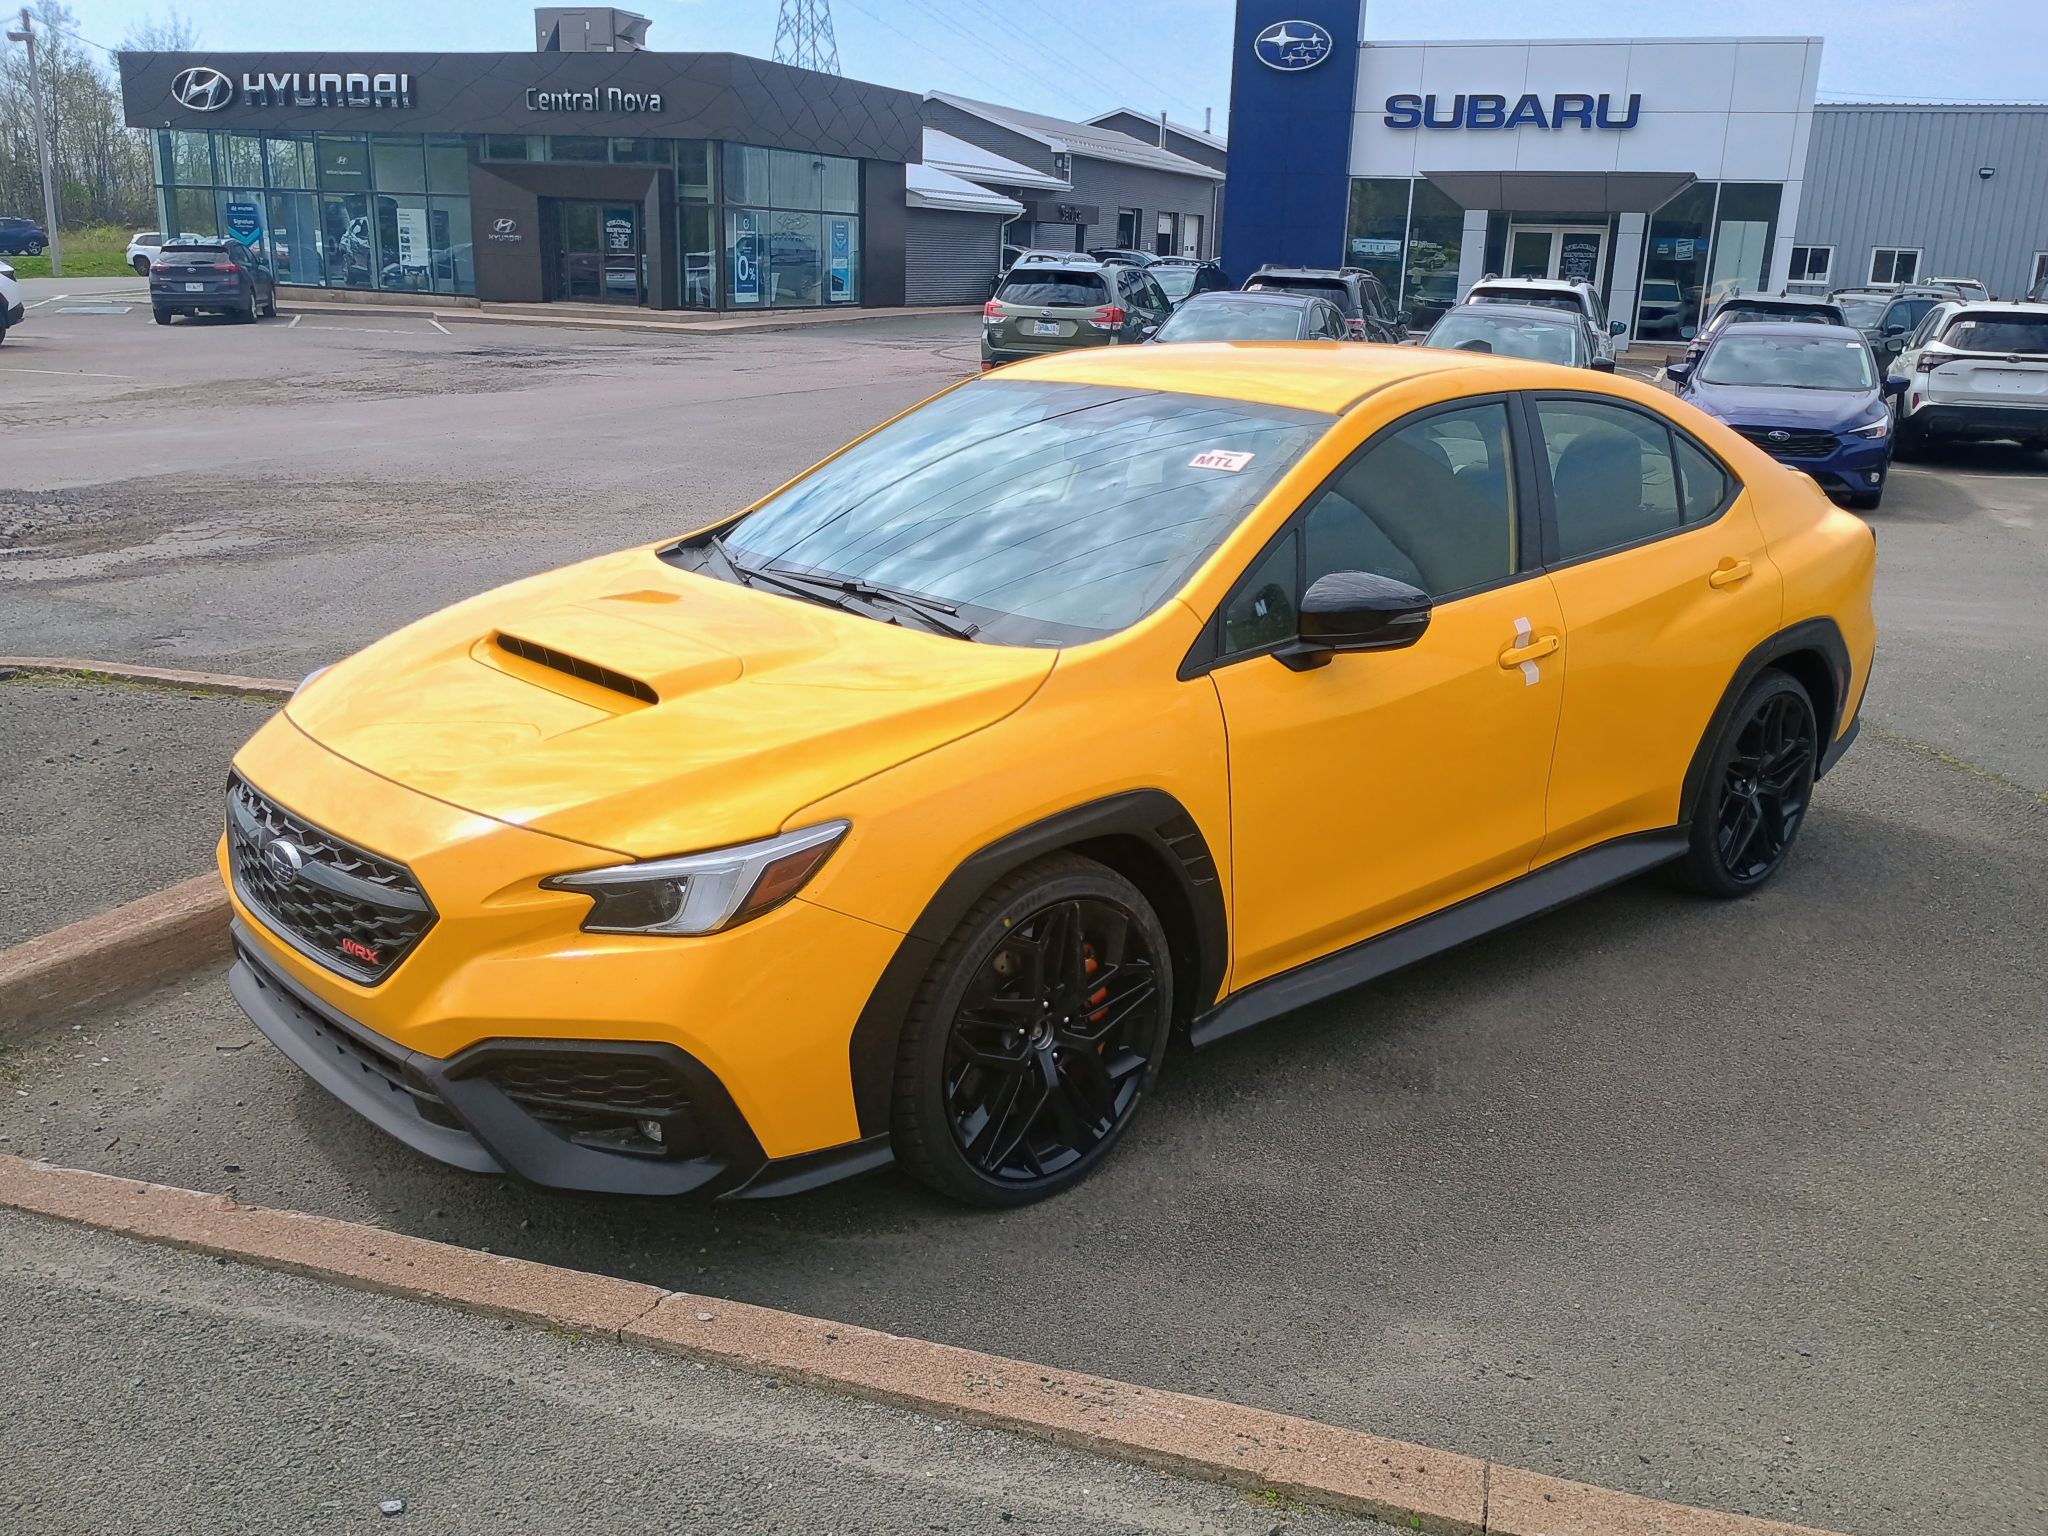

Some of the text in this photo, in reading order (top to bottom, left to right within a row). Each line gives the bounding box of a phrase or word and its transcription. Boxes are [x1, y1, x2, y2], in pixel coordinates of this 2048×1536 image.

[242, 73, 410, 108] HYUNDAI
[525, 87, 661, 112] Central Nova
[1383, 93, 1642, 129] SUBARU
[488, 233, 522, 242] HYUNDAI
[1195, 455, 1234, 469] MTL
[342, 937, 380, 965] WRX
